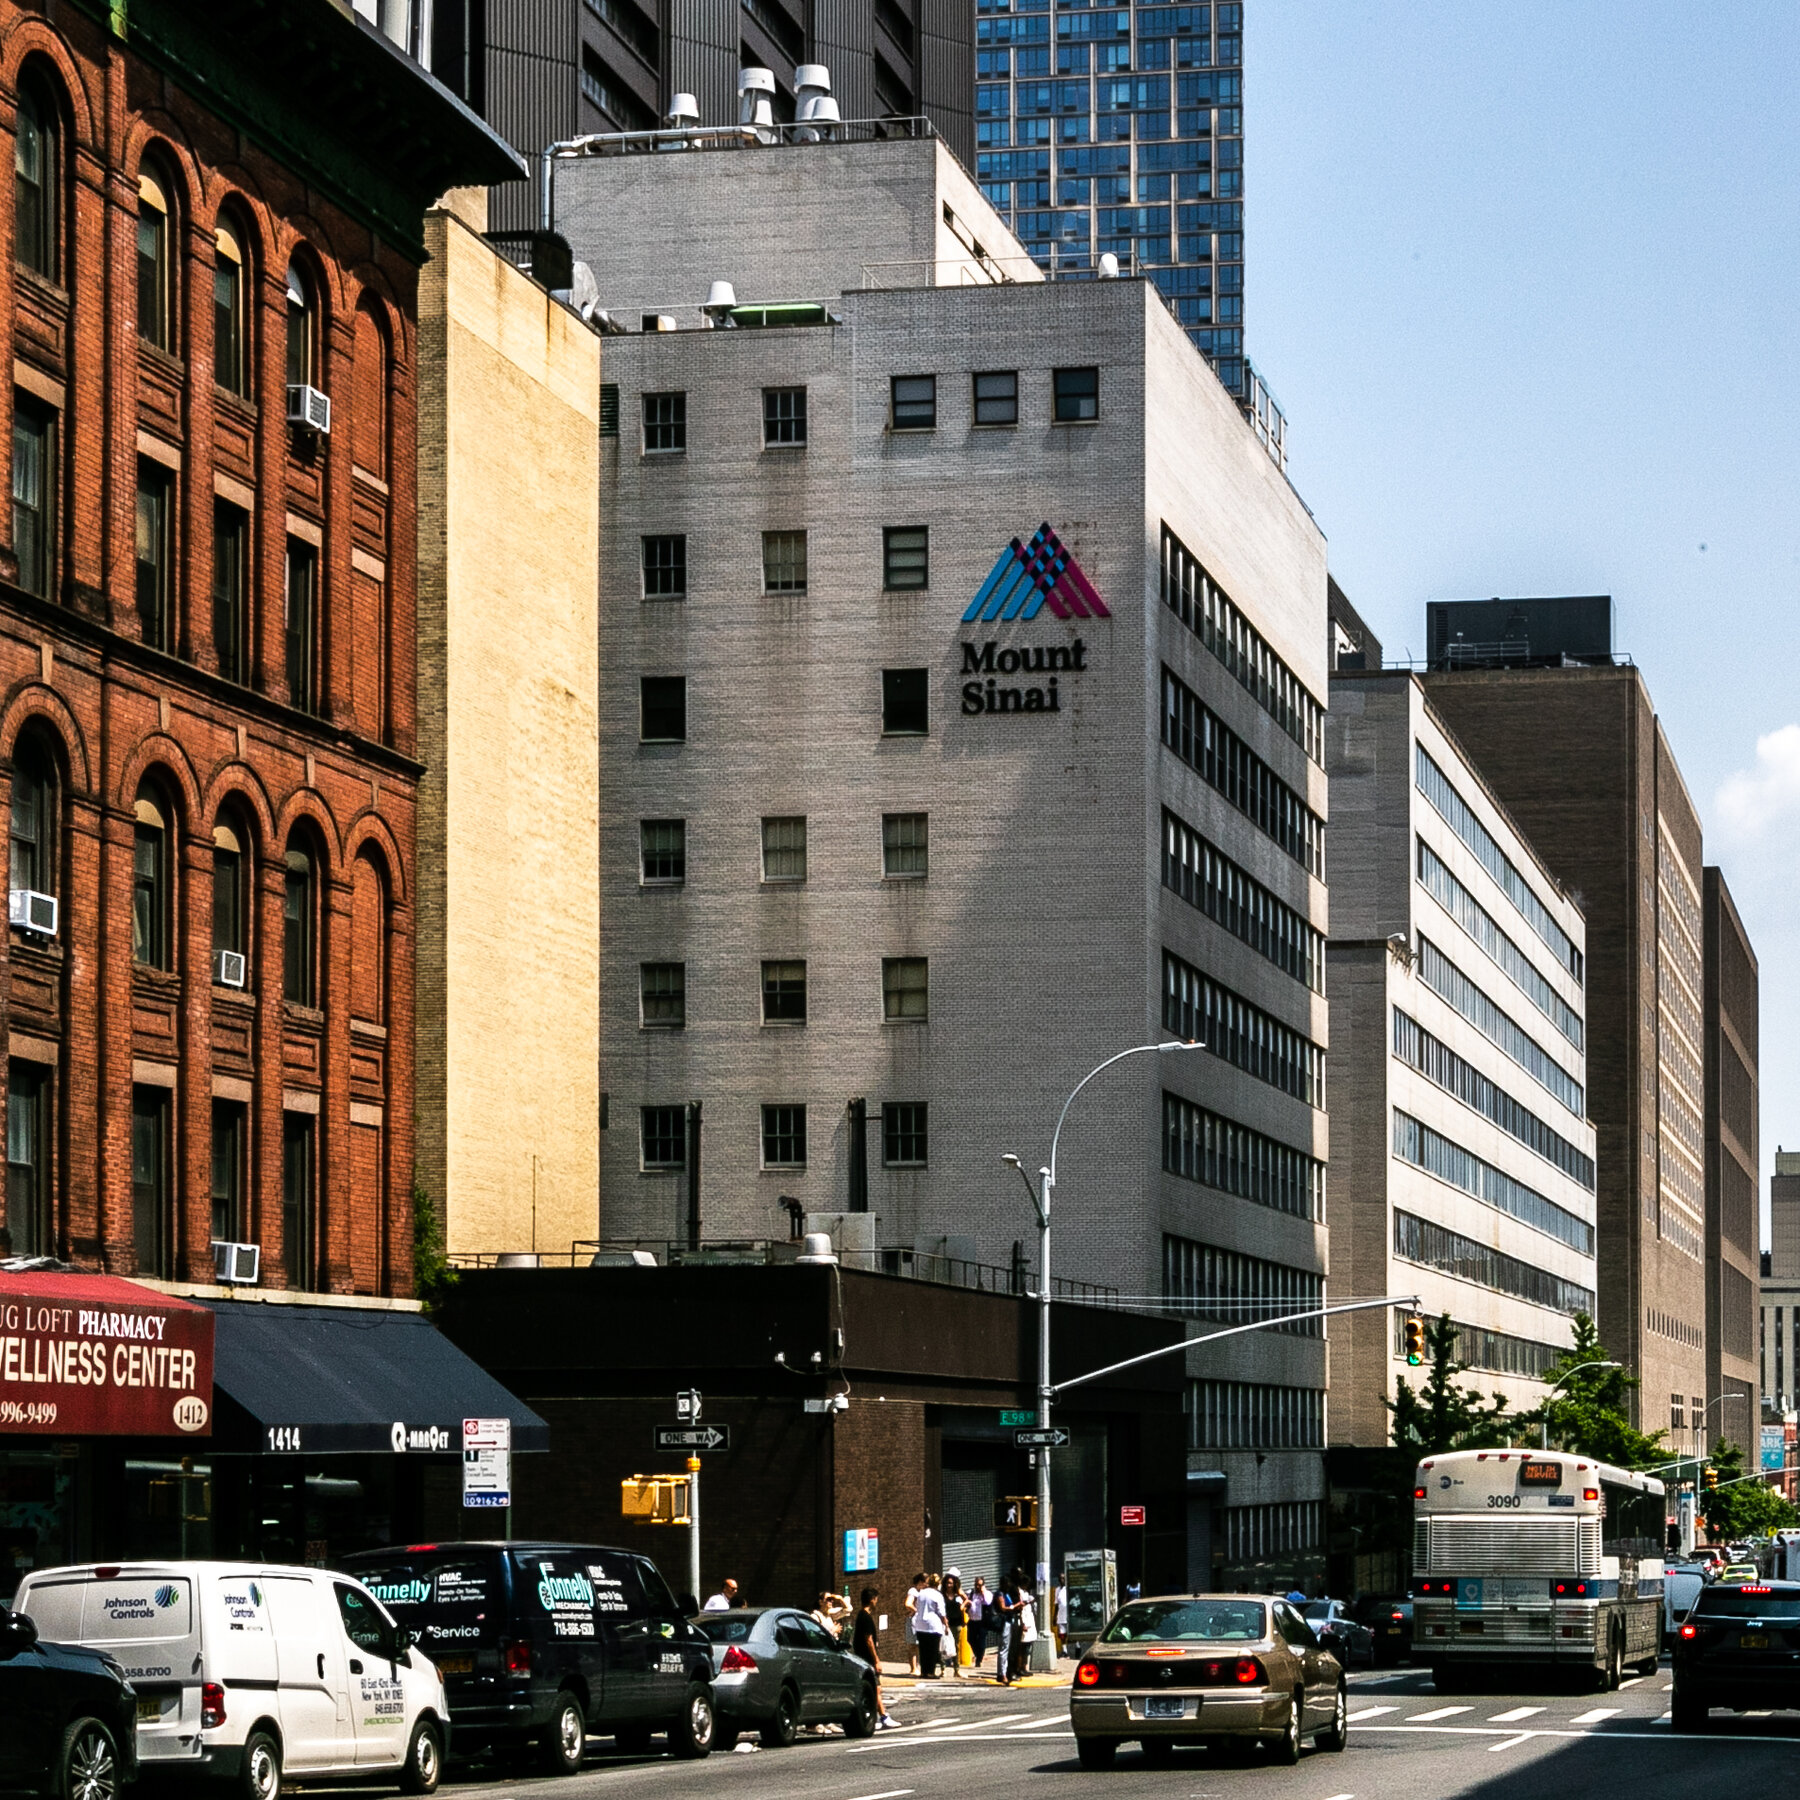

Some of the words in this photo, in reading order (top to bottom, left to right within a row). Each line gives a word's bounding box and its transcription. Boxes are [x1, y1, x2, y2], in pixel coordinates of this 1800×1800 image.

[960, 638, 1087, 674] Mount
[961, 676, 1061, 715] Sinai
[25, 1306, 72, 1333] LOFT
[78, 1309, 167, 1340] PHARMACY
[0, 1336, 107, 1386] ELLNESS
[112, 1343, 196, 1390] CENTER
[0, 1401, 58, 1424] 996-9499
[178, 1404, 203, 1425] 1412
[1011, 1412, 1025, 1424] 98
[268, 1427, 300, 1450] 1414
[665, 1433, 687, 1443] ONE
[695, 1433, 718, 1443] WAY
[1019, 1434, 1034, 1443] ONE
[1044, 1433, 1062, 1443] WAY
[1525, 1472, 1558, 1480] SERVICE
[1487, 1495, 1521, 1509] 3090
[439, 1572, 462, 1582] HVAC
[104, 1597, 147, 1609] Johnson
[224, 1593, 247, 1606] Johnson
[110, 1607, 155, 1619] Controls
[230, 1606, 255, 1618] Controls
[432, 1625, 481, 1639] Service
